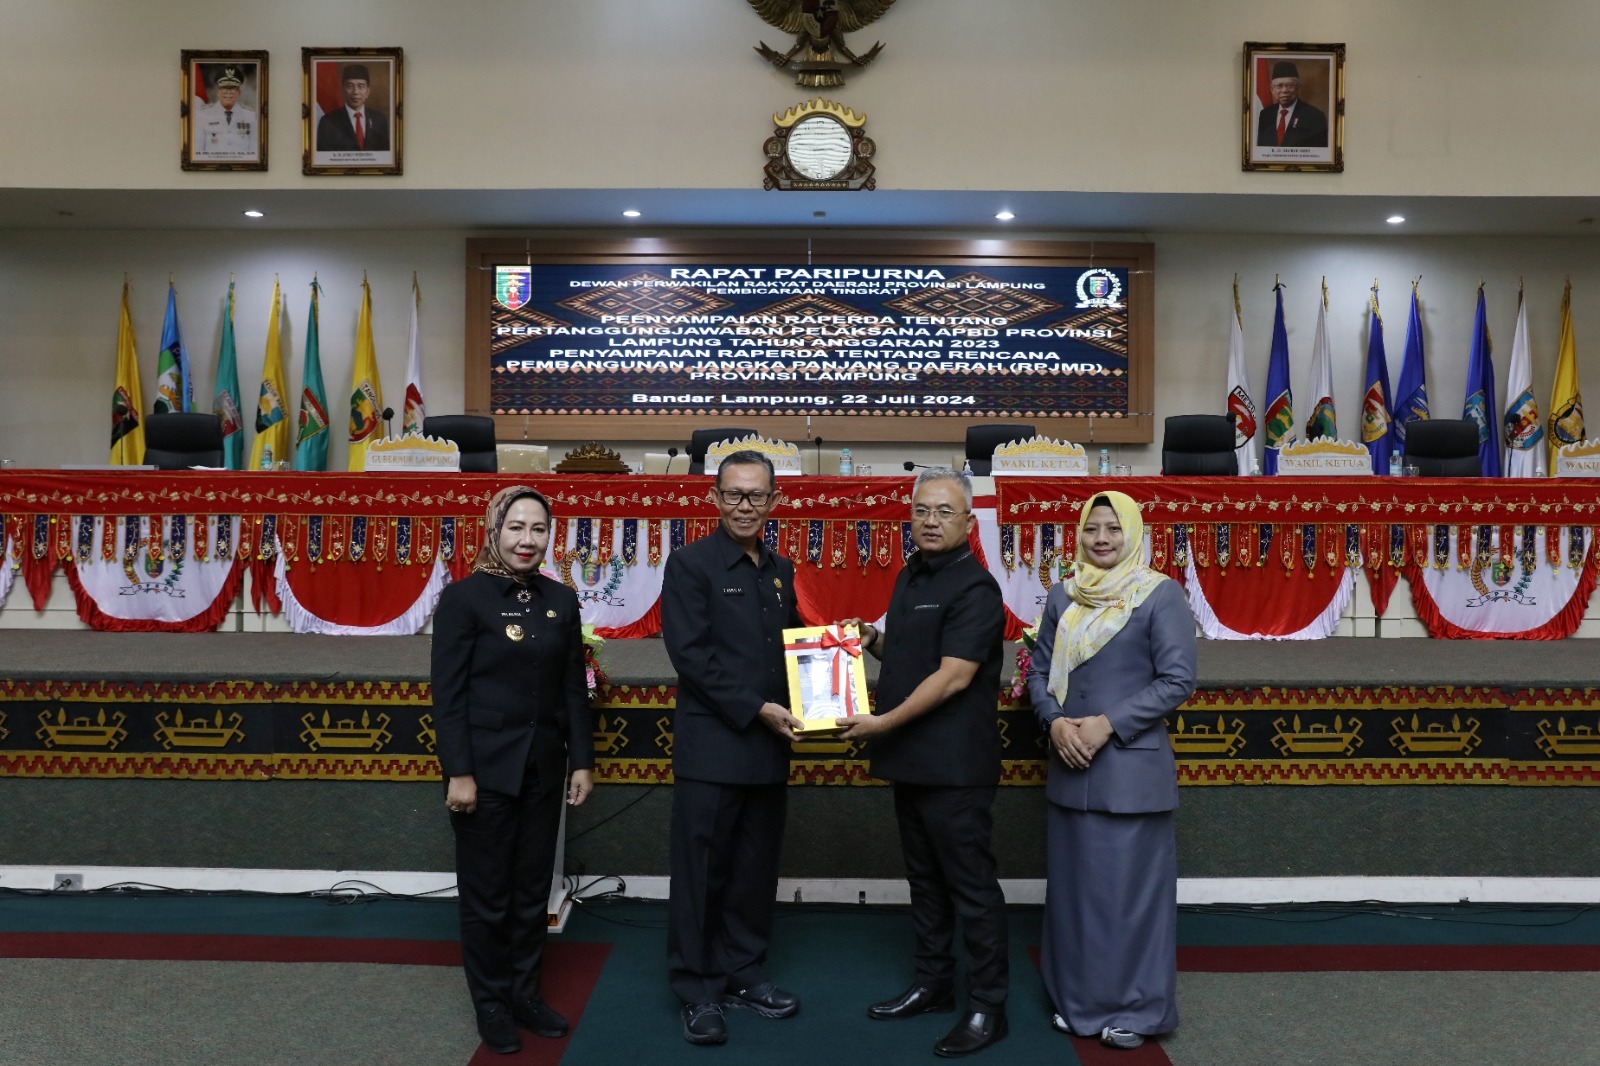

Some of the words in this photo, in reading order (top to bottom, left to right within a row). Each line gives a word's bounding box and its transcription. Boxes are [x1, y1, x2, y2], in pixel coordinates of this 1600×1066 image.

[671, 268, 767, 279] RAPAT
[774, 268, 946, 280] PARIPURNA
[569, 280, 627, 288] DEWAN
[634, 280, 741, 288] PERWAKILAN
[747, 280, 808, 288] RAKYAT
[812, 281, 879, 289] DAERAH
[884, 281, 961, 290] PROVINSI
[965, 282, 1046, 290] LAMPUNG
[706, 287, 825, 295] PEMBICARAAN
[904, 288, 909, 296] I
[601, 314, 777, 323] PEENYAMPAIAN
[784, 314, 895, 324] RAPERDA
[901, 316, 1008, 325] TENTANG
[497, 326, 784, 335] PERTANGGUNGJAWABAN
[791, 327, 931, 336] PELAKSANA
[936, 328, 1000, 337] APBD
[1006, 328, 1112, 338] PROVINSI
[608, 338, 722, 347] LAMPUNG
[732, 338, 806, 347] TAHUN
[811, 338, 944, 347] ANGGARAN
[950, 339, 1000, 348] 2023
[549, 349, 711, 358] PENYAMPAIAN
[718, 349, 829, 358] RAPERDA
[834, 350, 942, 359] TENTANG
[949, 351, 1061, 360] RENCANA
[506, 360, 685, 369] PEMBANGUNAN
[692, 360, 786, 369] JANGKA
[792, 361, 901, 370] PANJANG
[907, 362, 1004, 371] DAERAH
[1009, 362, 1104, 374] (RPJMD)
[689, 372, 798, 381] PROVINSI
[804, 372, 918, 381] LAMPUNG
[632, 394, 714, 403] Bandar
[721, 395, 834, 406] Lampung,
[842, 395, 869, 404] 22
[875, 395, 916, 404] Juli
[923, 395, 976, 404] 2024
[371, 456, 414, 464] GUBERNUR
[415, 456, 453, 465] LAMPUNG
[1000, 459, 1039, 469] WAKIL
[1041, 459, 1081, 469] KETUA
[1285, 458, 1322, 468] WAKIL
[1325, 458, 1364, 468] KETUA
[137, 583, 169, 592] DPRD
[1485, 591, 1518, 600] DPRD
